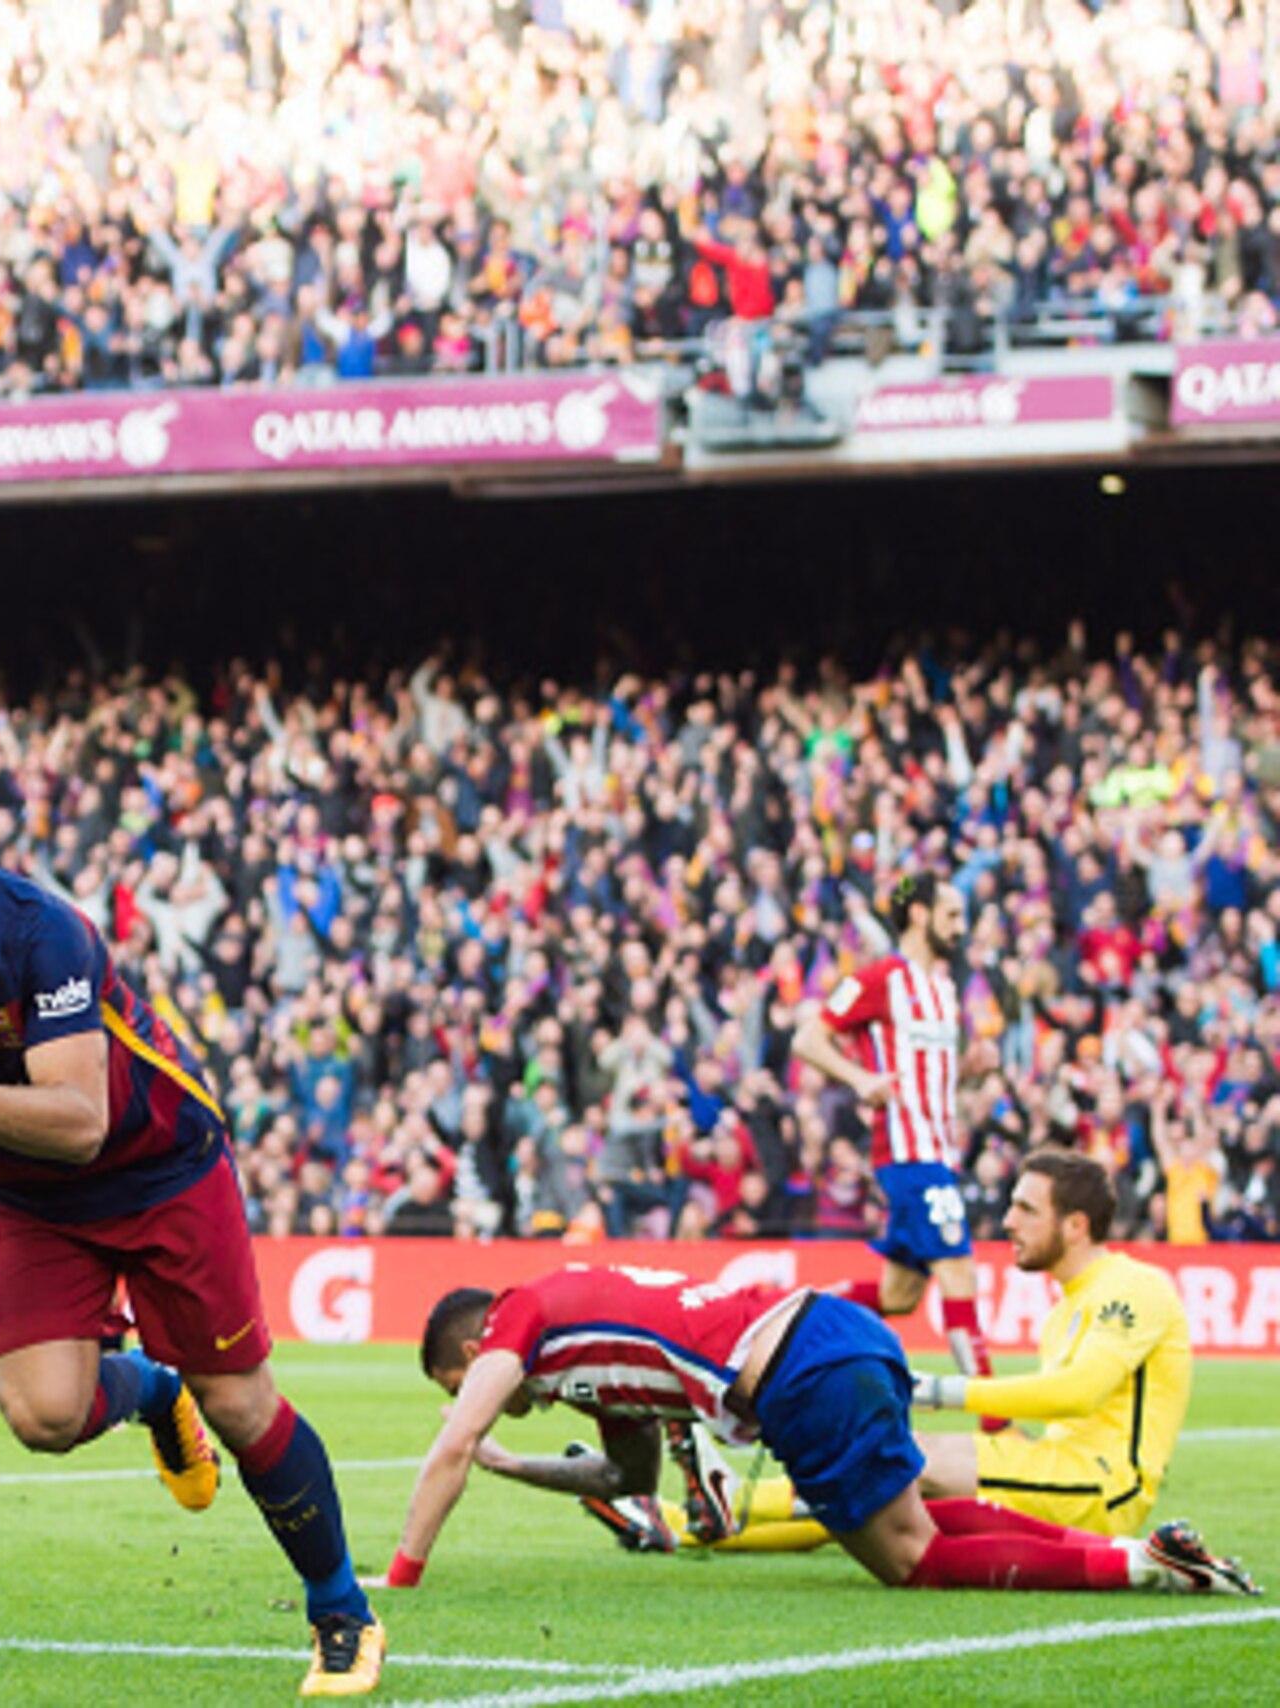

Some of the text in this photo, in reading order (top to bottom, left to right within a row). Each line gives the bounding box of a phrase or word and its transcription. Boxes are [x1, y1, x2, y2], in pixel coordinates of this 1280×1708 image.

[252, 400, 551, 461] QATAR AIRWAYS
[288, 1245, 374, 1344] G
